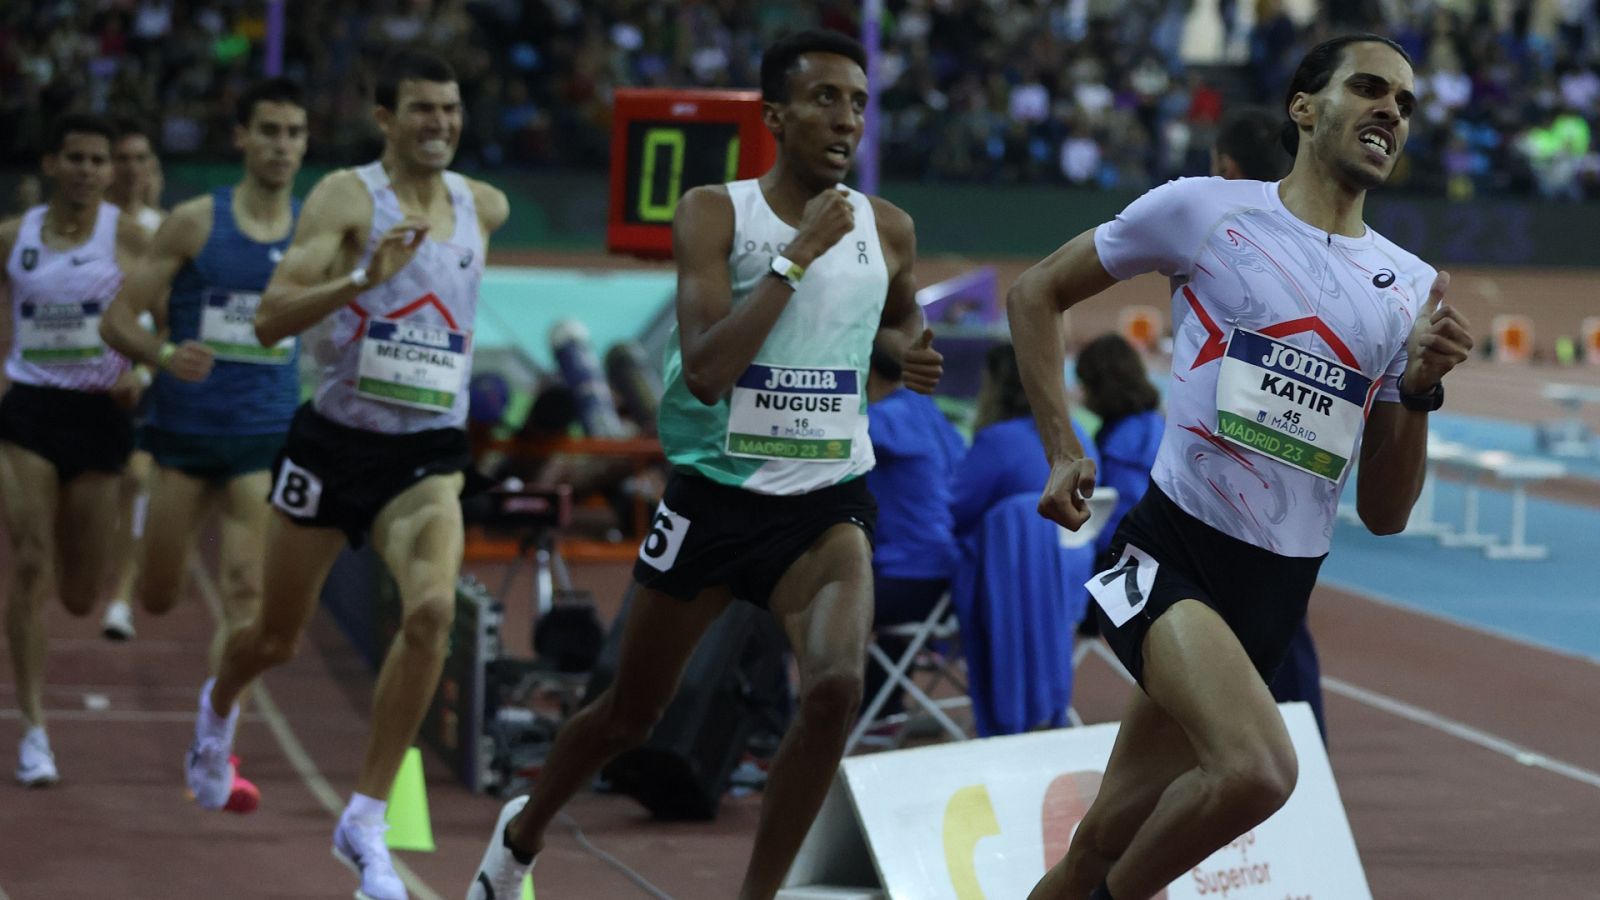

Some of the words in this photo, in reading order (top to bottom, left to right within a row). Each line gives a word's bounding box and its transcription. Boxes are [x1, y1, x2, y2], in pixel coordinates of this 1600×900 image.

[377, 344, 456, 369] MECHAAL
[755, 393, 842, 412] NUGUSE
[1260, 373, 1333, 417] KATIR
[794, 418, 808, 428] 16
[1271, 416, 1317, 442] MADRID
[1283, 408, 1300, 425] 45
[785, 427, 825, 437] MADRID
[1220, 418, 1280, 452] MADRID
[1281, 443, 1303, 462] 23
[739, 441, 797, 456] MADRID
[800, 445, 818, 457] 23
[282, 472, 309, 508] 8
[645, 512, 673, 558] 6
[1099, 555, 1144, 608] 7
[1192, 862, 1272, 898] Superior
